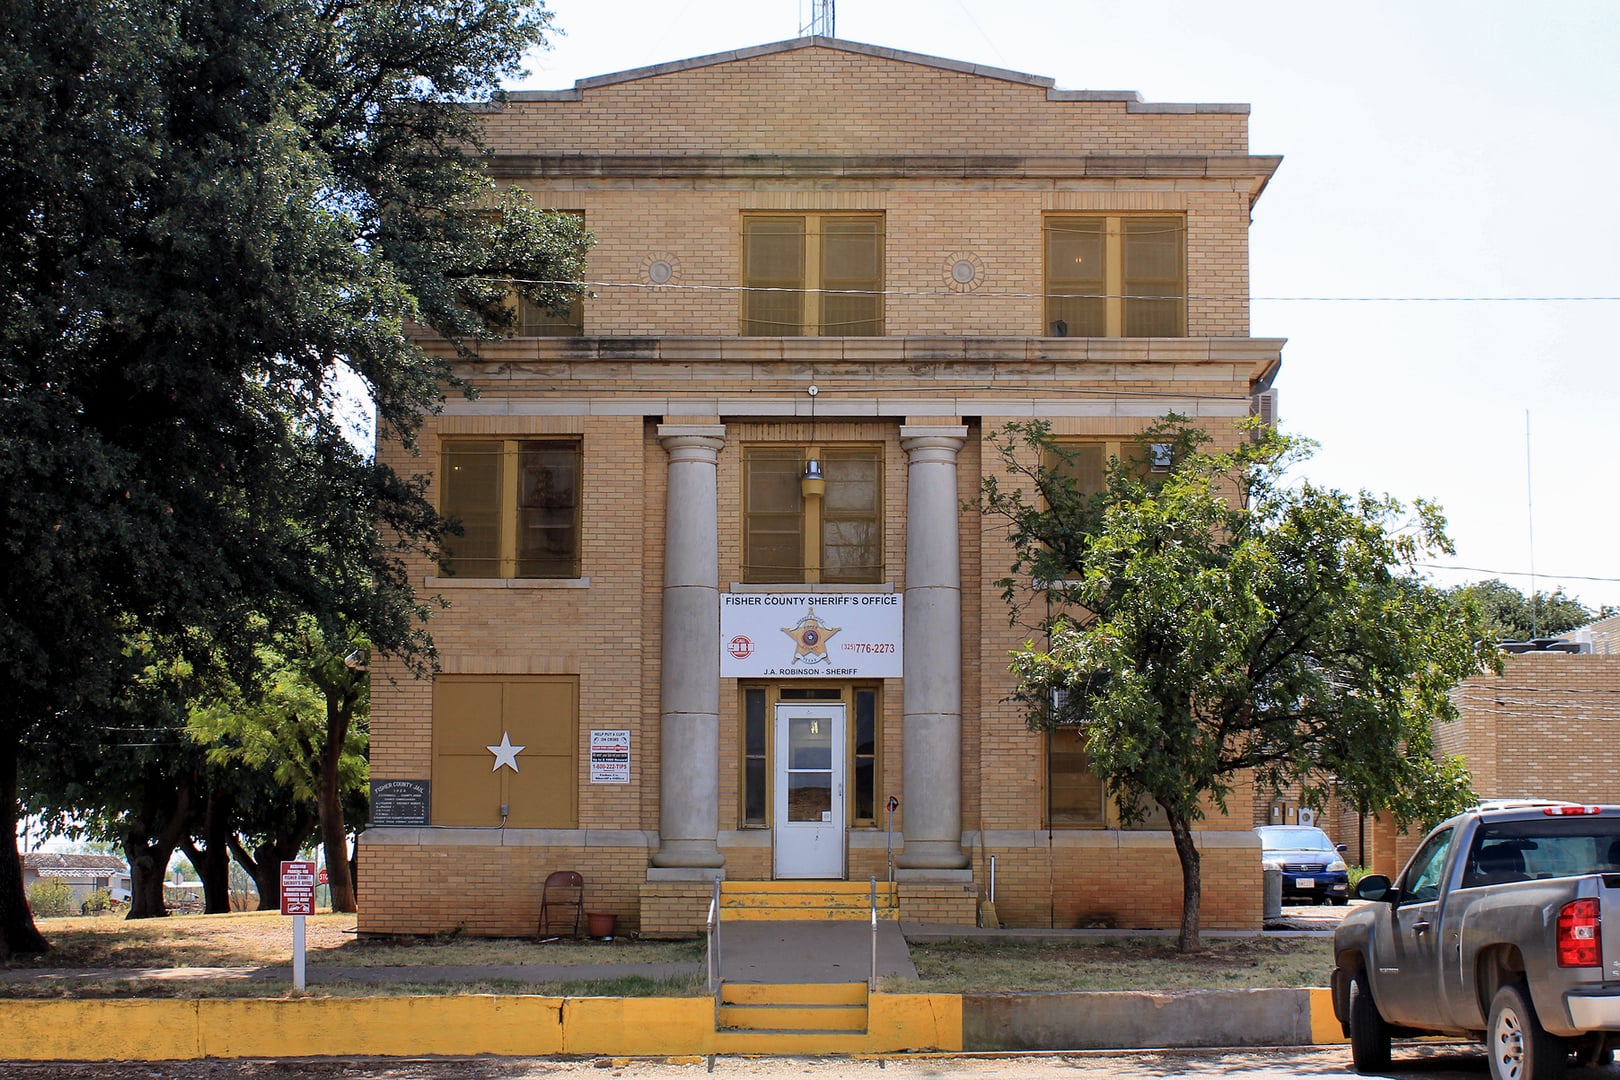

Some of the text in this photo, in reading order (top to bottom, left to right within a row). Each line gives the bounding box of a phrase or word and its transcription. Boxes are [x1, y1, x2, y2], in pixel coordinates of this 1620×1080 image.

[725, 596, 898, 606] FISHER COUNTY SHERIFF'S OFFICE
[763, 668, 778, 676] J.A.
[779, 668, 820, 676] ROBINSON
[825, 668, 859, 676] SHERIFF
[374, 782, 393, 794] FISHER
[412, 784, 424, 794] JAIL
